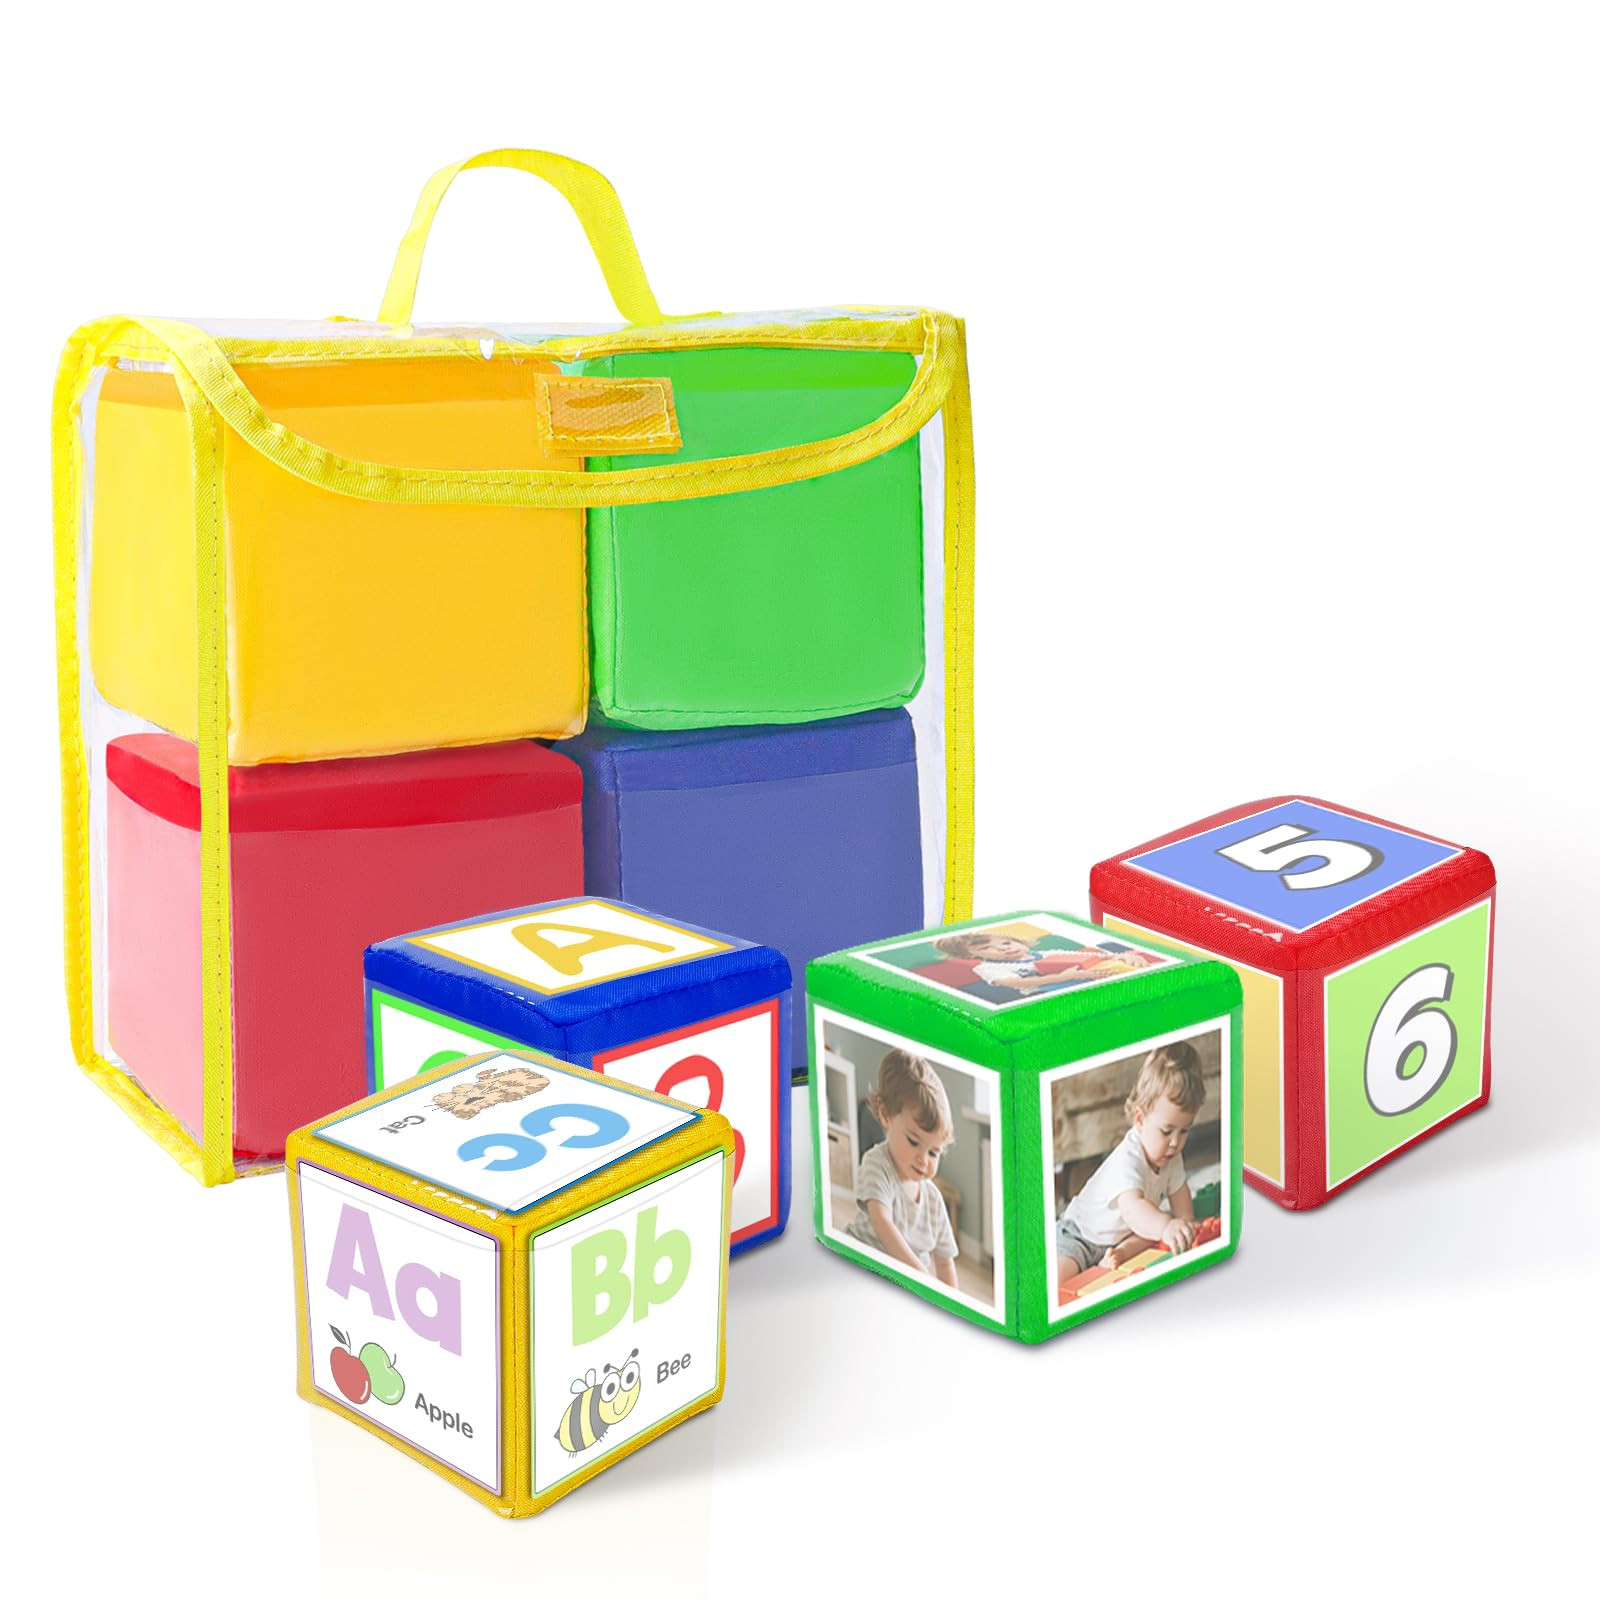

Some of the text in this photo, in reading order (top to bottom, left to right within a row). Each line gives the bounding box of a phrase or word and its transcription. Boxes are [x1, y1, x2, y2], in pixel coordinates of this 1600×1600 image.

[1214, 823, 1386, 891] 5
[511, 922, 676, 976] A
[1363, 962, 1458, 1117] 6
[378, 1114, 426, 1134] Cat
[325, 1202, 463, 1357] Aa
[571, 1205, 692, 1347] Bb
[656, 1353, 692, 1385] Bee
[414, 1392, 474, 1440] Apple
